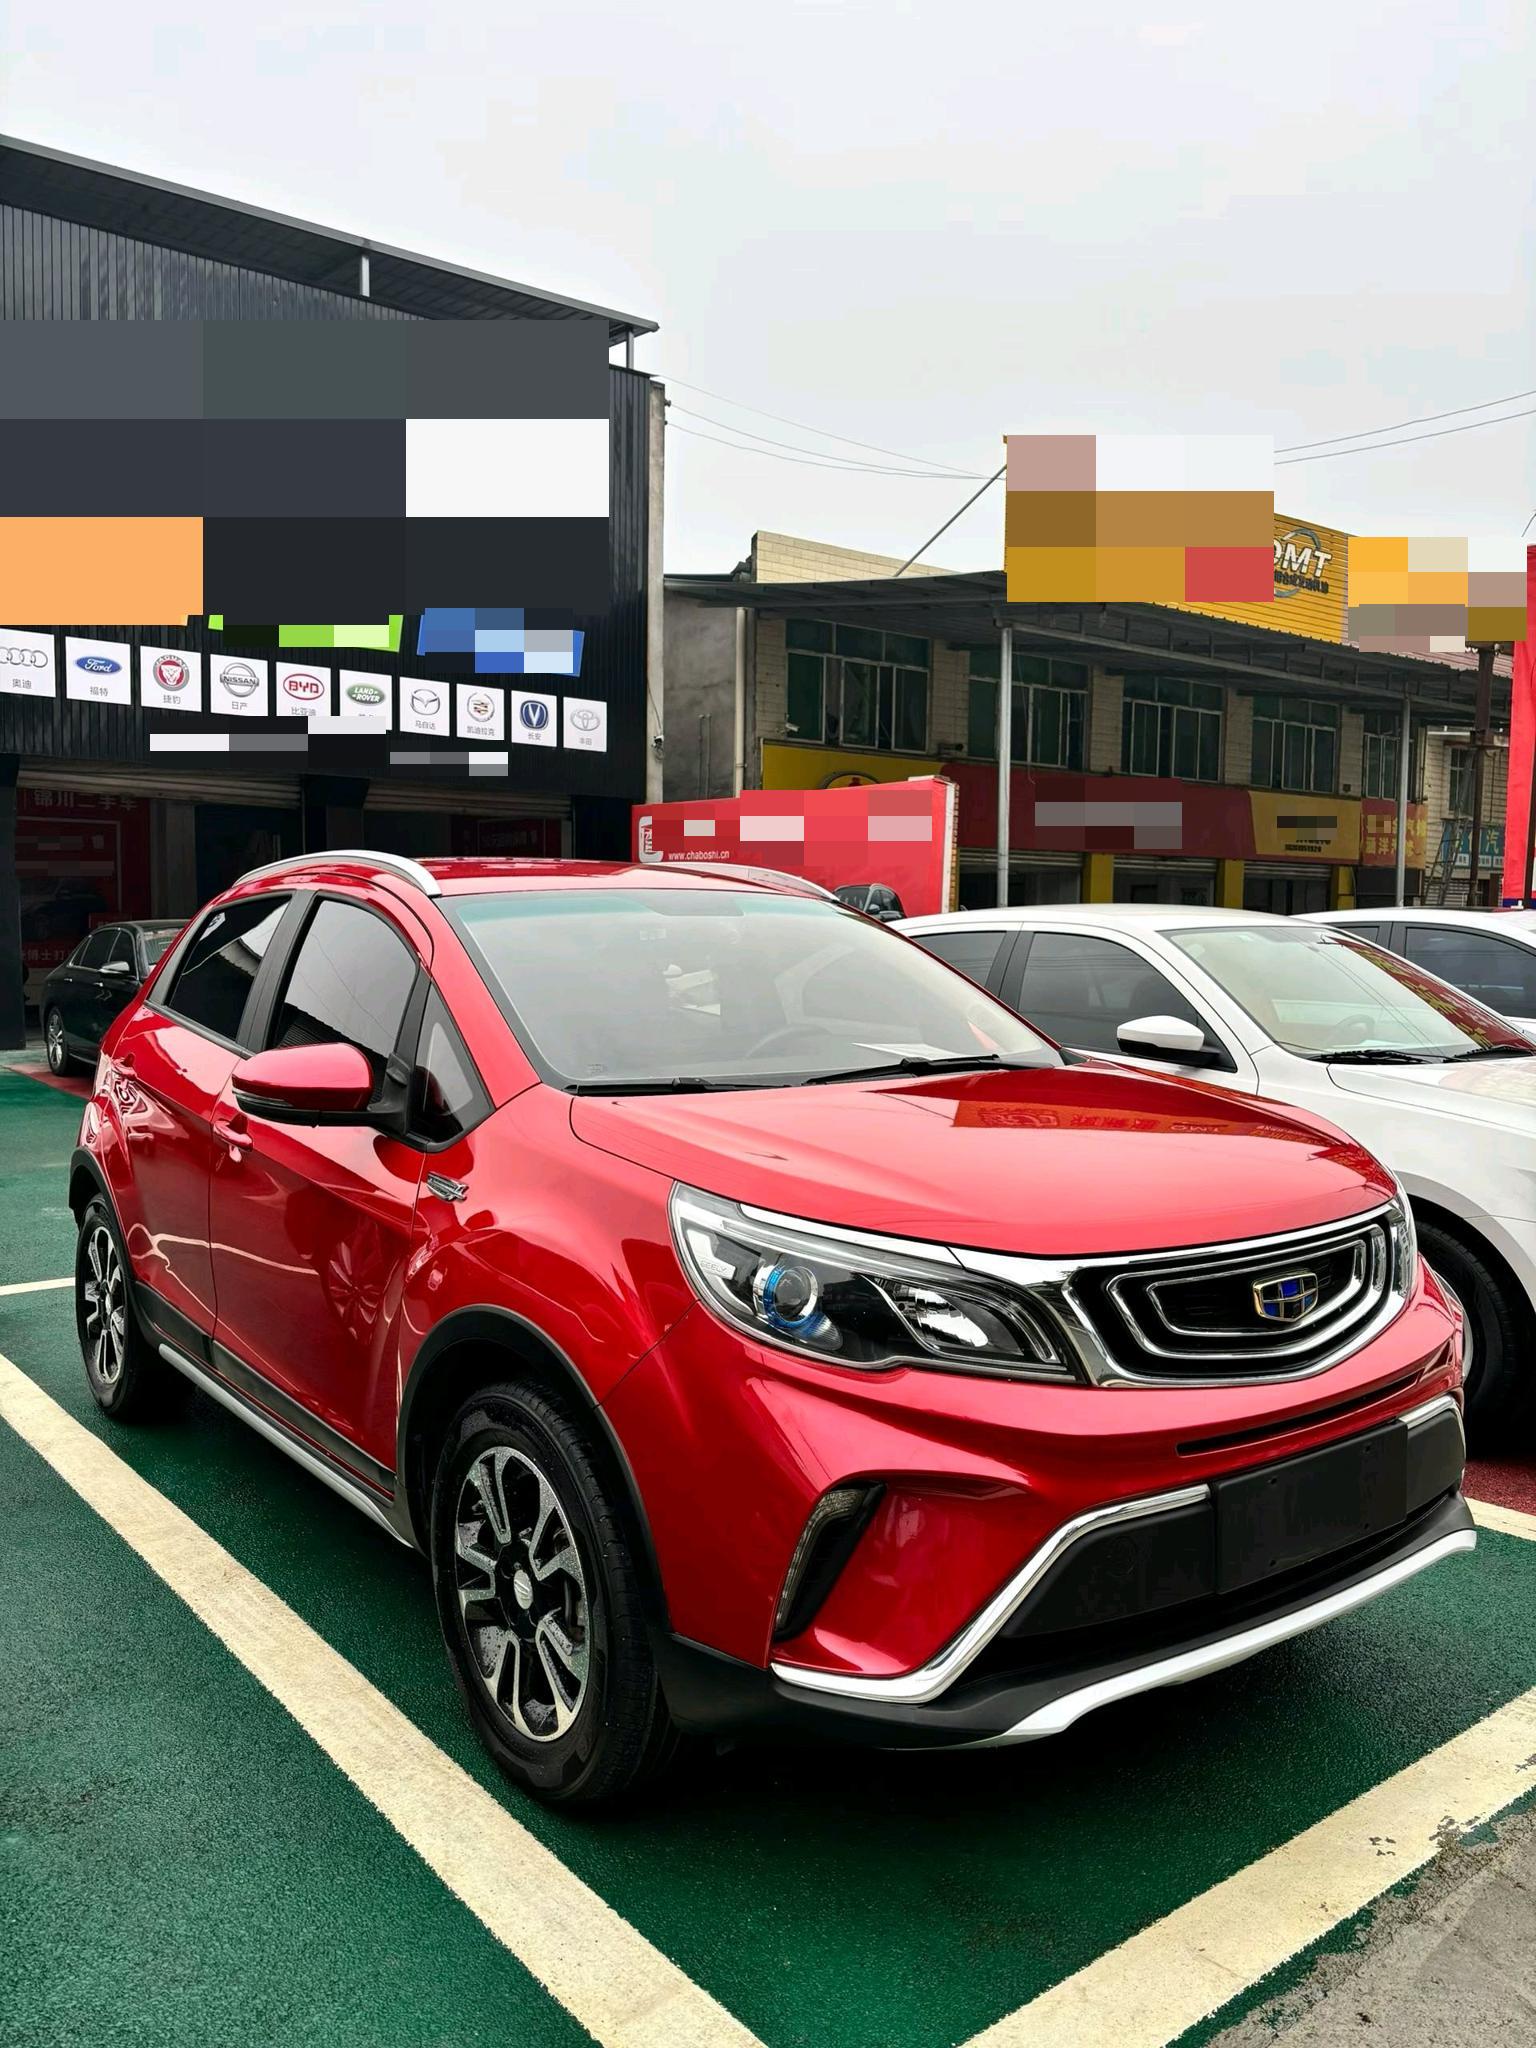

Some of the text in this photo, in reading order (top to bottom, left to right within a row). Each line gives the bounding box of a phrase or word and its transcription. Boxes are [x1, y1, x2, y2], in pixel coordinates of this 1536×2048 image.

[84, 657, 113, 673] Ford
[12, 678, 32, 689] 奥迪
[222, 675, 258, 686] NISSAN
[89, 686, 109, 697] 福特
[288, 680, 319, 694] BYD
[354, 687, 374, 696] LAND
[163, 694, 181, 705] 捷豹
[355, 693, 381, 703] ROVER
[231, 701, 248, 711] 日产
[291, 706, 317, 716] 比亚迪
[415, 720, 436, 731] 马自达
[466, 725, 495, 737] 凯迪拉克
[528, 731, 542, 741] 长安
[578, 737, 592, 746] 丰田
[668, 850, 730, 861] www.chaboshi.cn
